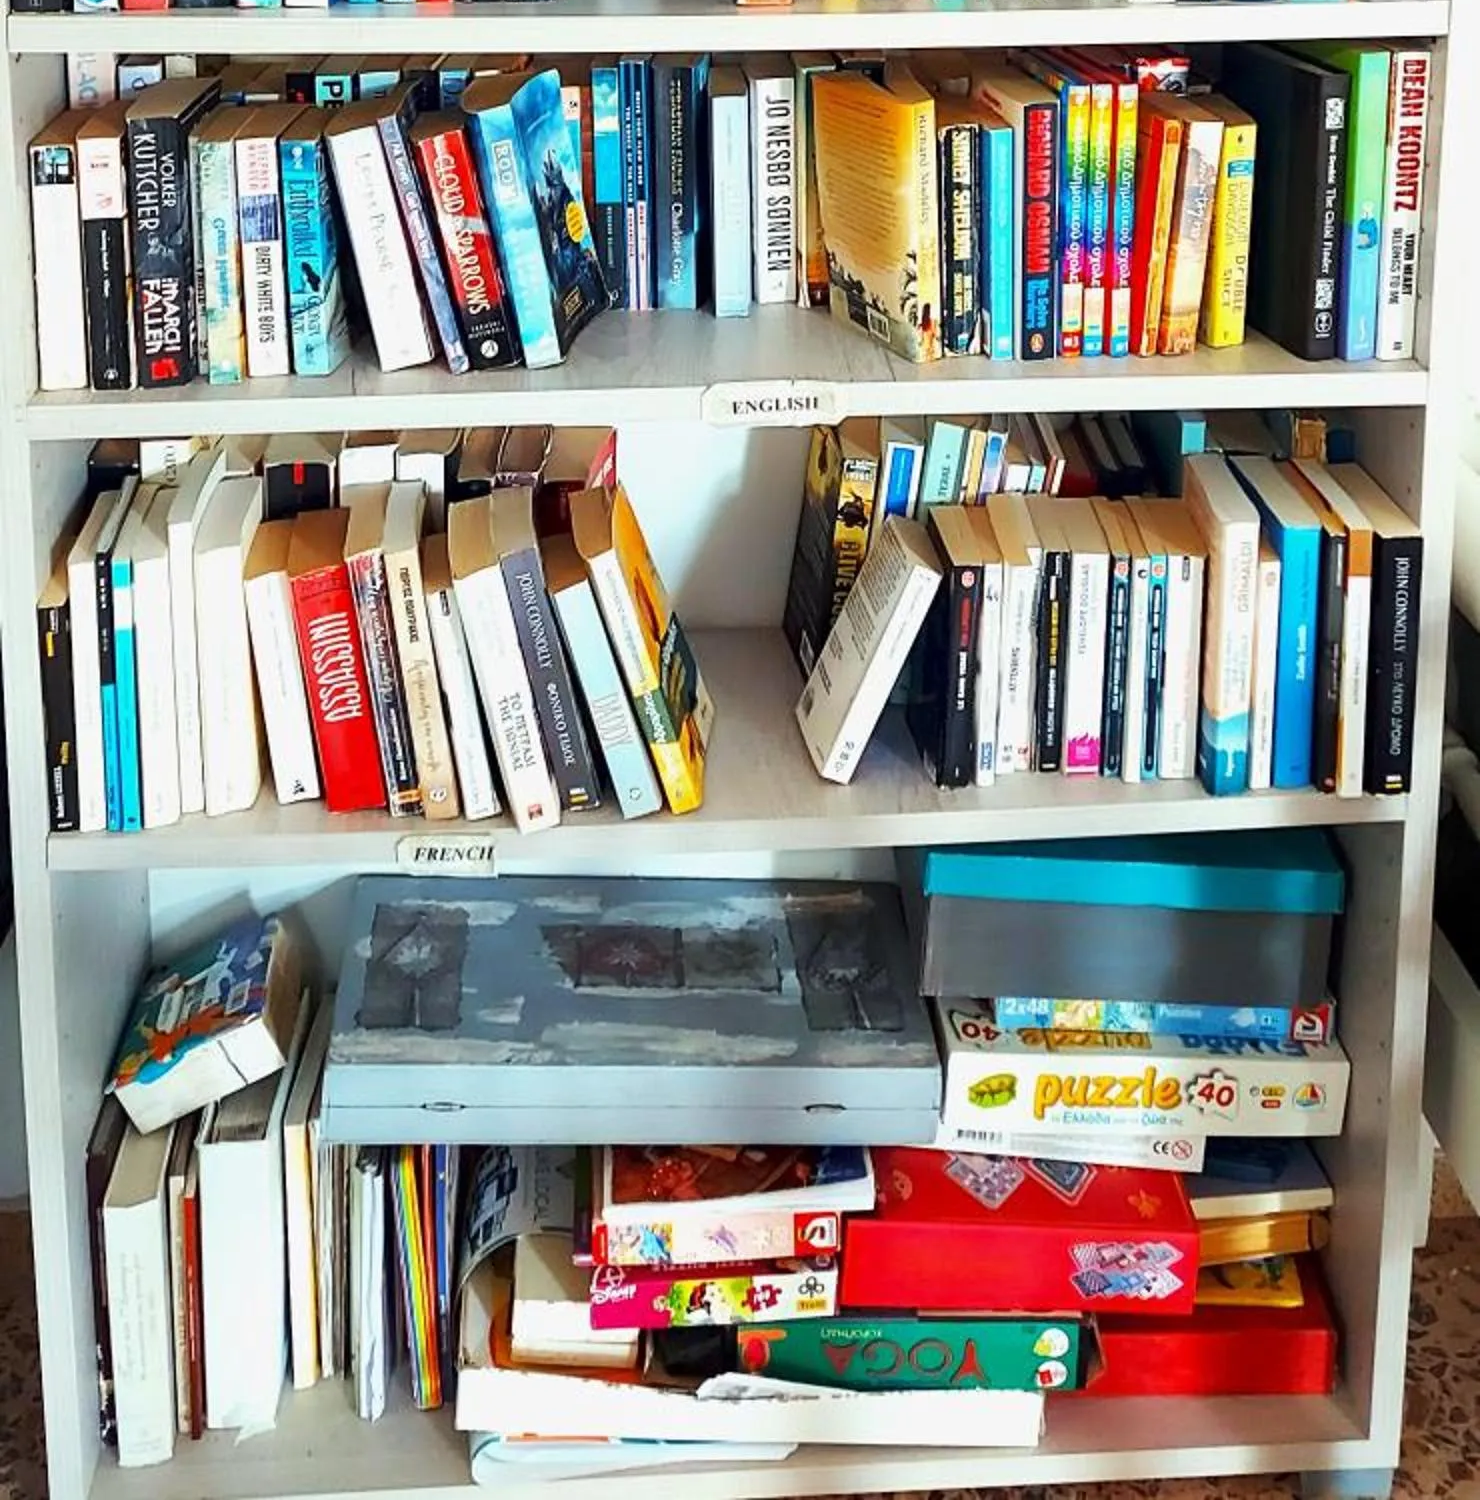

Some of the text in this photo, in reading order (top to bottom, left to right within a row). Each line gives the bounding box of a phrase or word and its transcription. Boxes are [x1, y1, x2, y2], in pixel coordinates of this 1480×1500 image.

[161, 152, 176, 208] VOLKER
[1394, 59, 1426, 213] DEAN KOONTZ
[133, 132, 160, 231] KUTSCHER
[766, 95, 791, 272] JO NESBØ SØNNEN
[1026, 109, 1052, 274] RICHARD OSMAN
[434, 154, 491, 315] CLOUD SPARROWS
[1320, 187, 1336, 275] The Child Finder
[1388, 228, 1403, 305] BELONGS TO ME
[1402, 233, 1415, 296] YOUR HEART
[255, 246, 275, 343] DIRTY WHITE BOYS
[732, 396, 819, 415] ENGLISH
[516, 571, 552, 669] JOHN CONNOLLY
[1393, 557, 1410, 653] JOHN CONNOLLY
[308, 612, 362, 723] ASSASSINI
[547, 683, 566, 732] ΦΟΝΙΚΟ
[415, 846, 494, 861] FRENCH
[1032, 1065, 1183, 1121] puzzle
[1195, 1081, 1236, 1108] 40
[823, 1337, 992, 1390] YOGA
